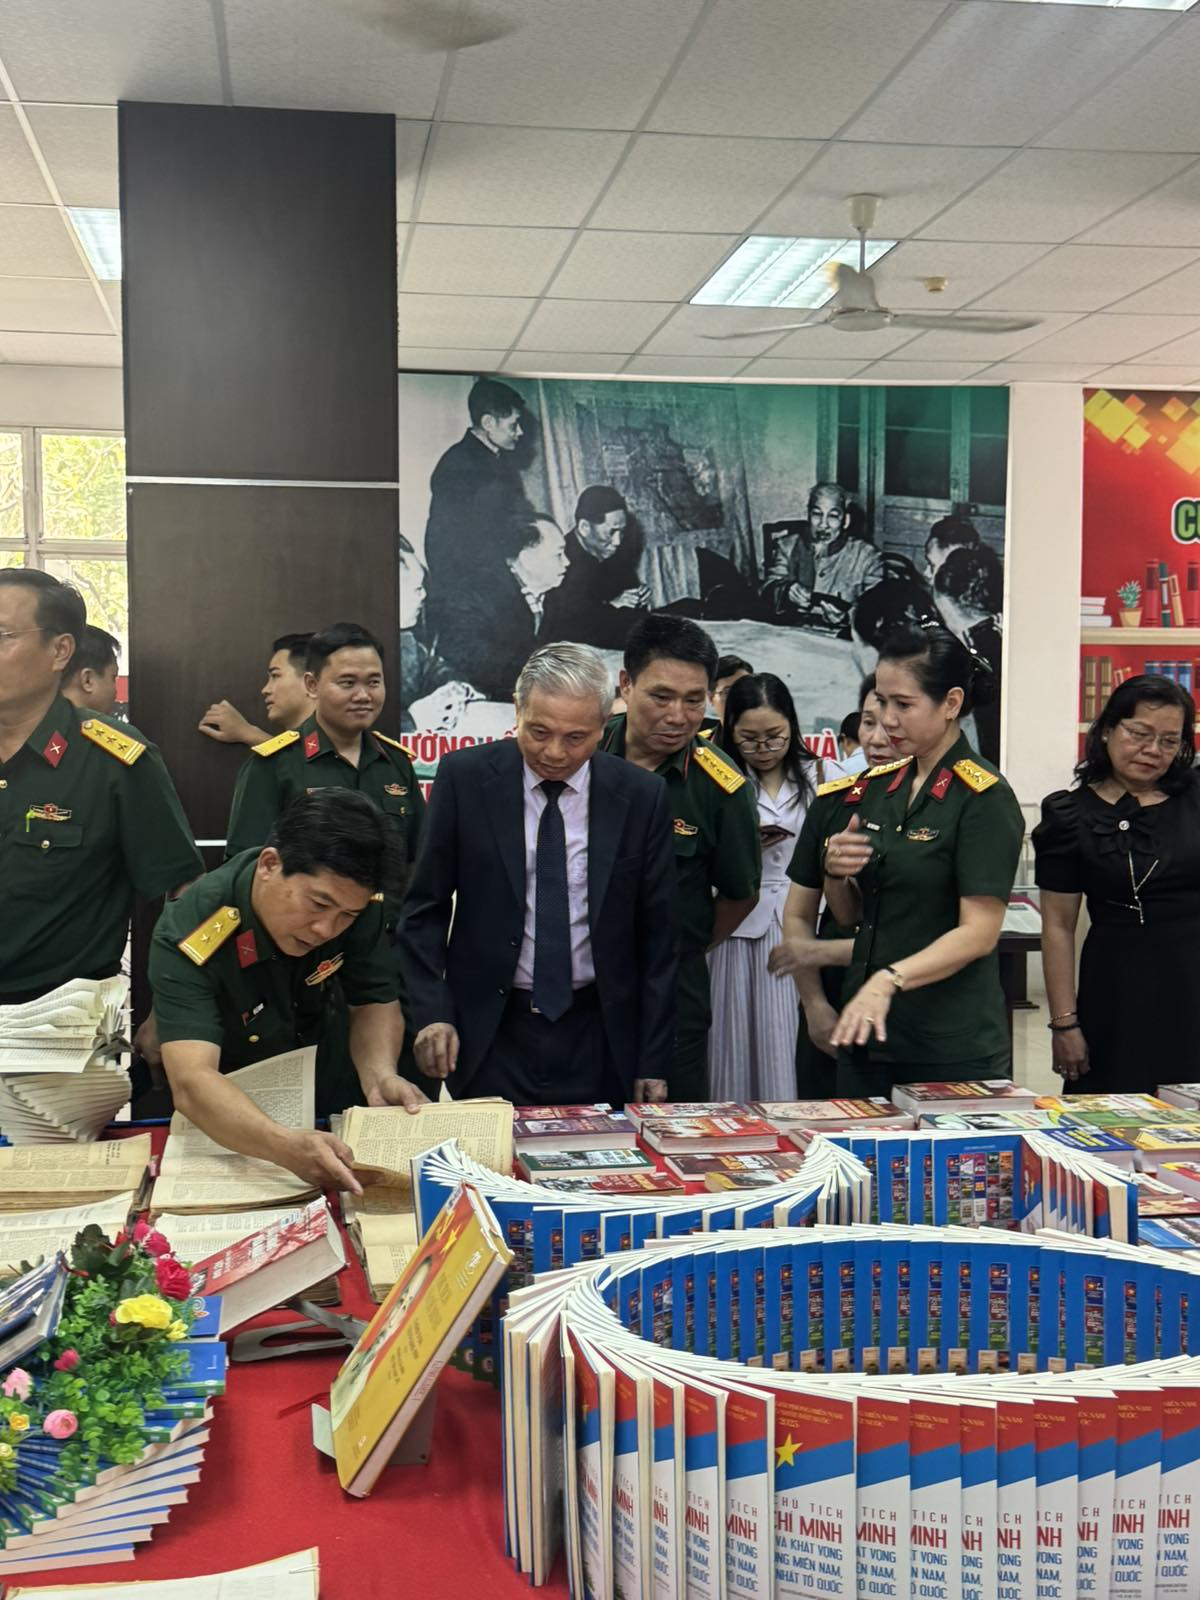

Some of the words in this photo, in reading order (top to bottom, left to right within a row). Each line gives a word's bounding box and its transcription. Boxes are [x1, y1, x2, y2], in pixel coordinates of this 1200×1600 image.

[1173, 499, 1200, 542] C
[800, 1515, 842, 1544] MINH
[856, 1521, 896, 1546] MINH
[997, 1527, 1021, 1550] NH
[1036, 1525, 1062, 1548] NH
